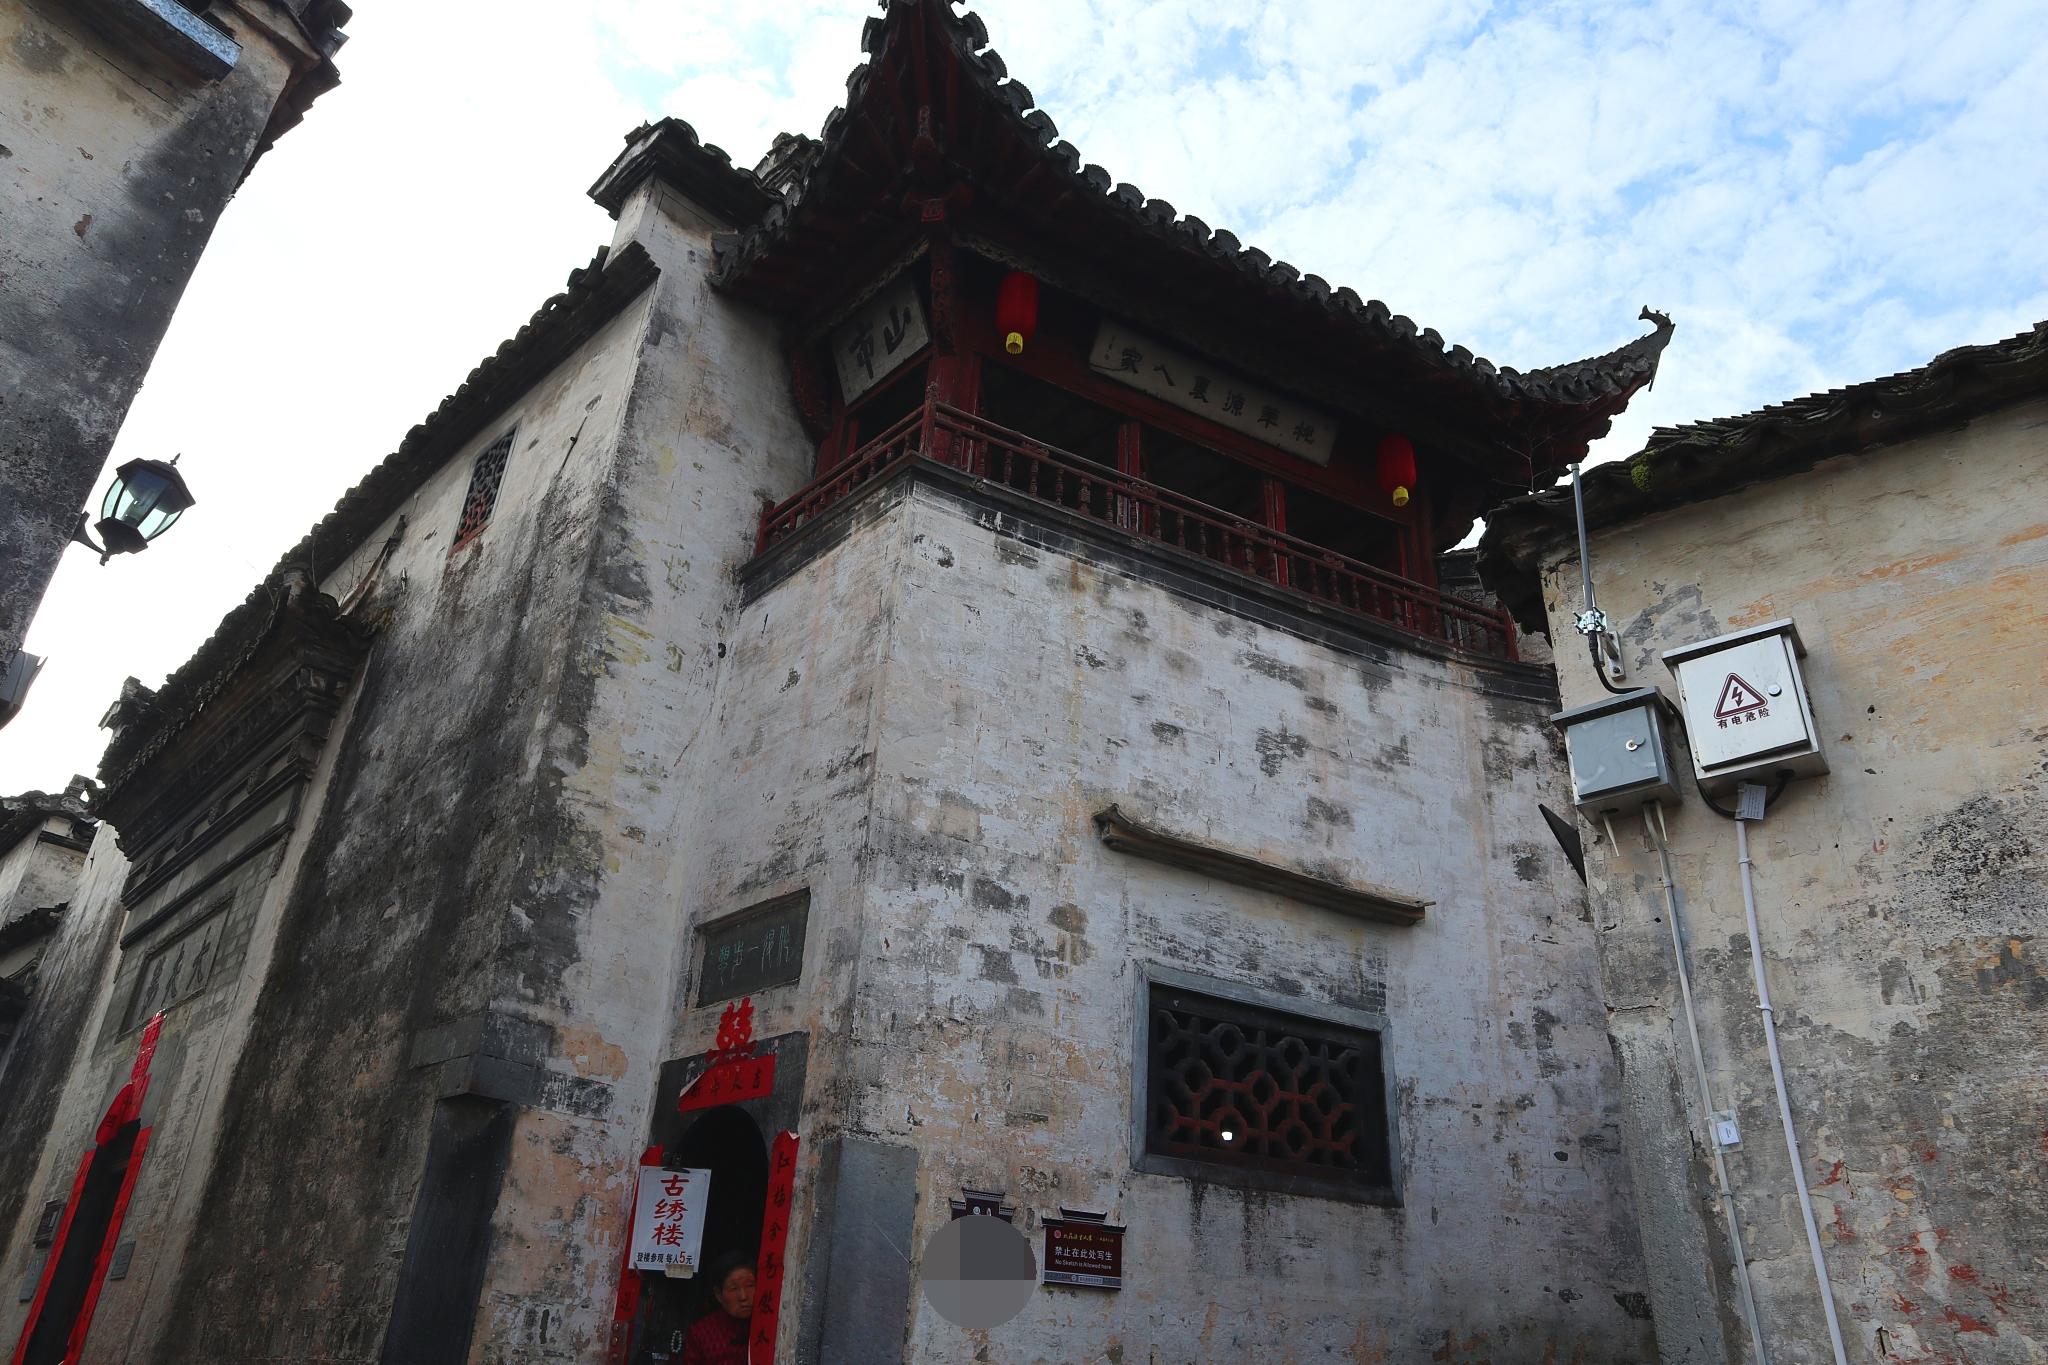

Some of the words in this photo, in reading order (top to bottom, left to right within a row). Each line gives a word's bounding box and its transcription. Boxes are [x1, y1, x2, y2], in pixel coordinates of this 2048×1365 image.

[1717, 708, 1770, 729] 有电危险
[651, 1175, 690, 1247] 古绣楼
[636, 1252, 664, 1263] 登楼参观
[666, 1251, 693, 1264] 每人5元
[1054, 1246, 1113, 1261] 禁止在此处写生
